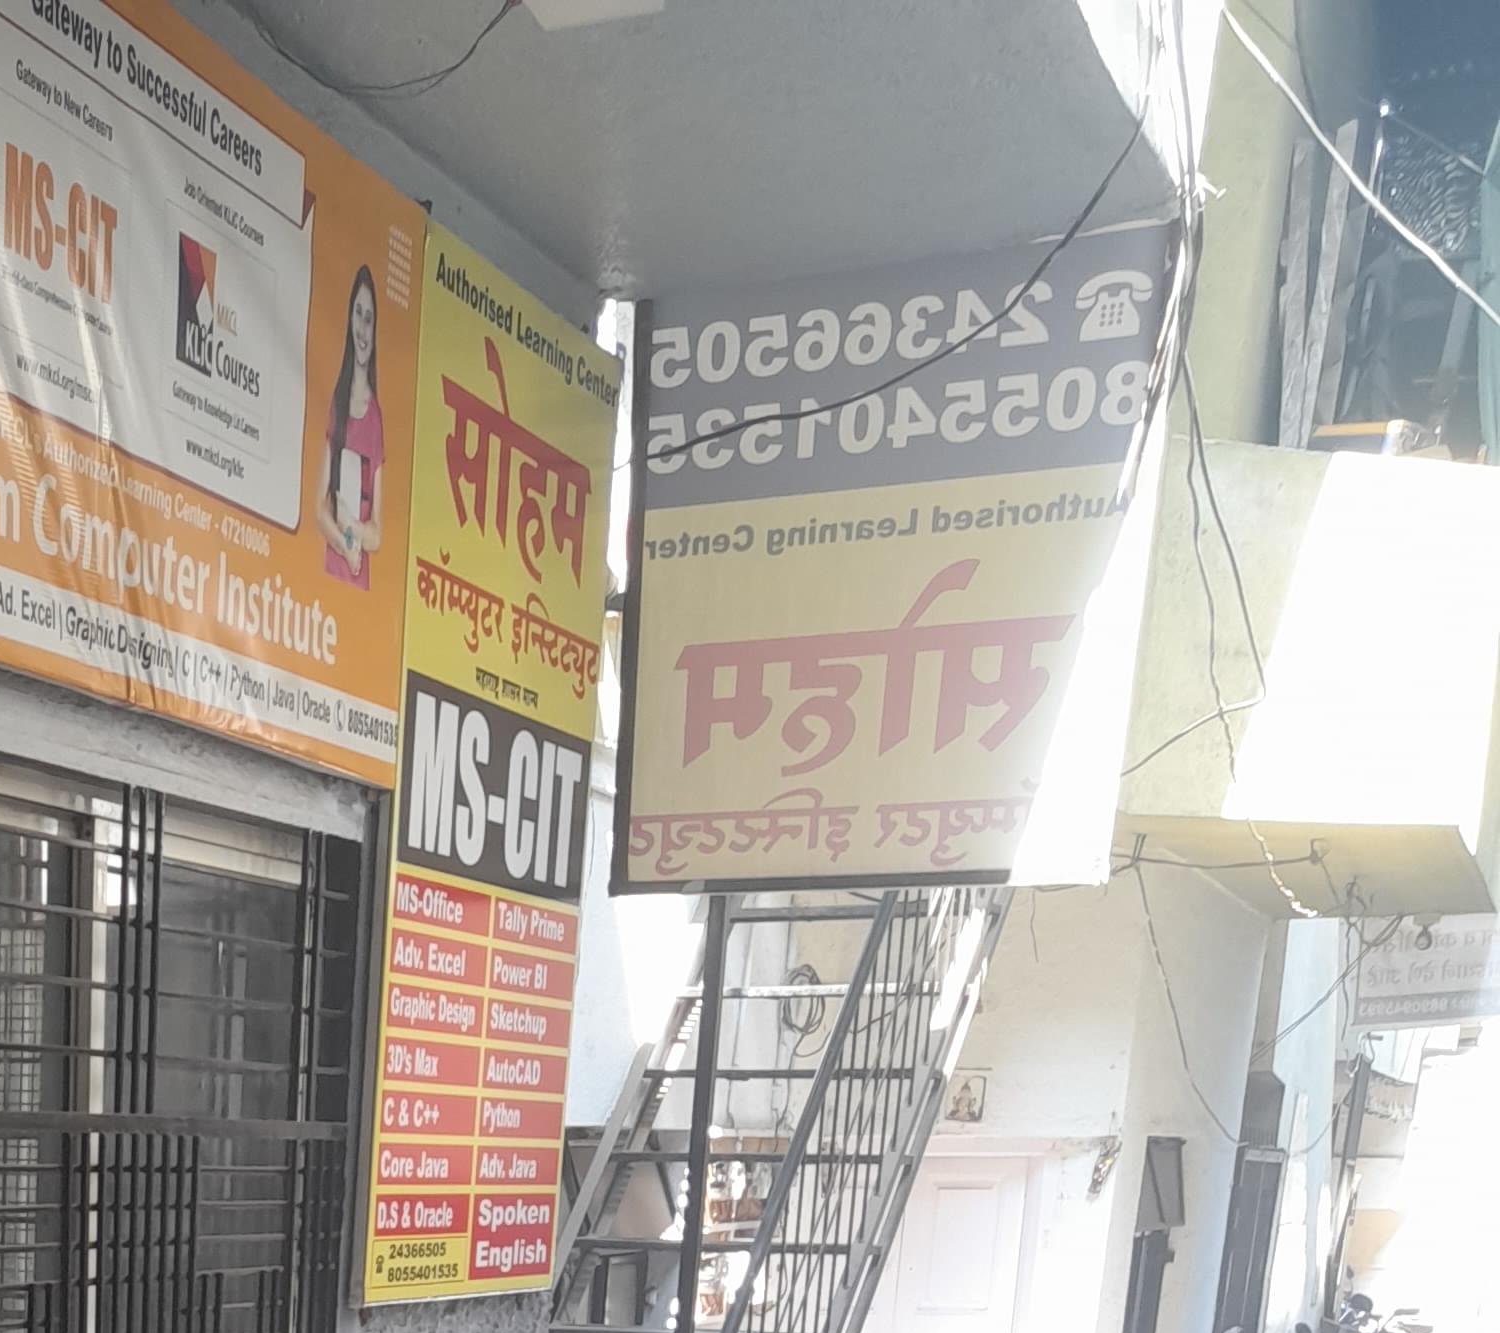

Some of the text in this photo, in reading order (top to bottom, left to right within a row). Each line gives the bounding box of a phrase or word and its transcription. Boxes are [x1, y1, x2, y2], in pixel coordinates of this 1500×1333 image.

[15, 58, 113, 142] Gateway to New Careers
[106, 30, 122, 74] to
[127, 43, 206, 137] Successful
[210, 107, 262, 177] Careers
[3, 141, 118, 304] MS-CIT
[239, 215, 264, 247] Courses
[435, 252, 619, 409] Authorised Learning Center
[215, 339, 260, 398] Courses
[441, 335, 592, 591] सोहम
[121, 466, 172, 521] Learning
[174, 492, 213, 533] Center
[32, 473, 211, 615] Computer
[216, 551, 338, 665] Institute
[21, 590, 56, 630] Excel
[65, 605, 115, 651] Graphic
[181, 649, 191, 677] C
[199, 655, 221, 683] C++
[229, 664, 265, 702] Python
[271, 673, 295, 713] Java
[302, 691, 331, 723] Oracle
[406, 690, 584, 889] MS-CIT
[396, 881, 463, 925] MS-Office
[498, 902, 565, 942] Tally Prime
[393, 936, 466, 977] Adv. Excel
[493, 956, 548, 990] Power BI
[390, 987, 476, 1032] Graphic Design
[490, 1002, 547, 1041] Sketchup
[387, 1044, 439, 1077] 3D's Max
[486, 1056, 541, 1086] AutoCAD
[383, 1096, 440, 1127] C & C++
[482, 1101, 521, 1134] Python
[380, 1150, 449, 1179] Core Java
[479, 1152, 537, 1179] Adv. Java
[377, 1201, 453, 1230] D.S & Oracle
[477, 1198, 550, 1233] Spoken
[389, 1241, 446, 1260] 24366505
[475, 1238, 547, 1273] English
[387, 1263, 459, 1283] 8055401535
